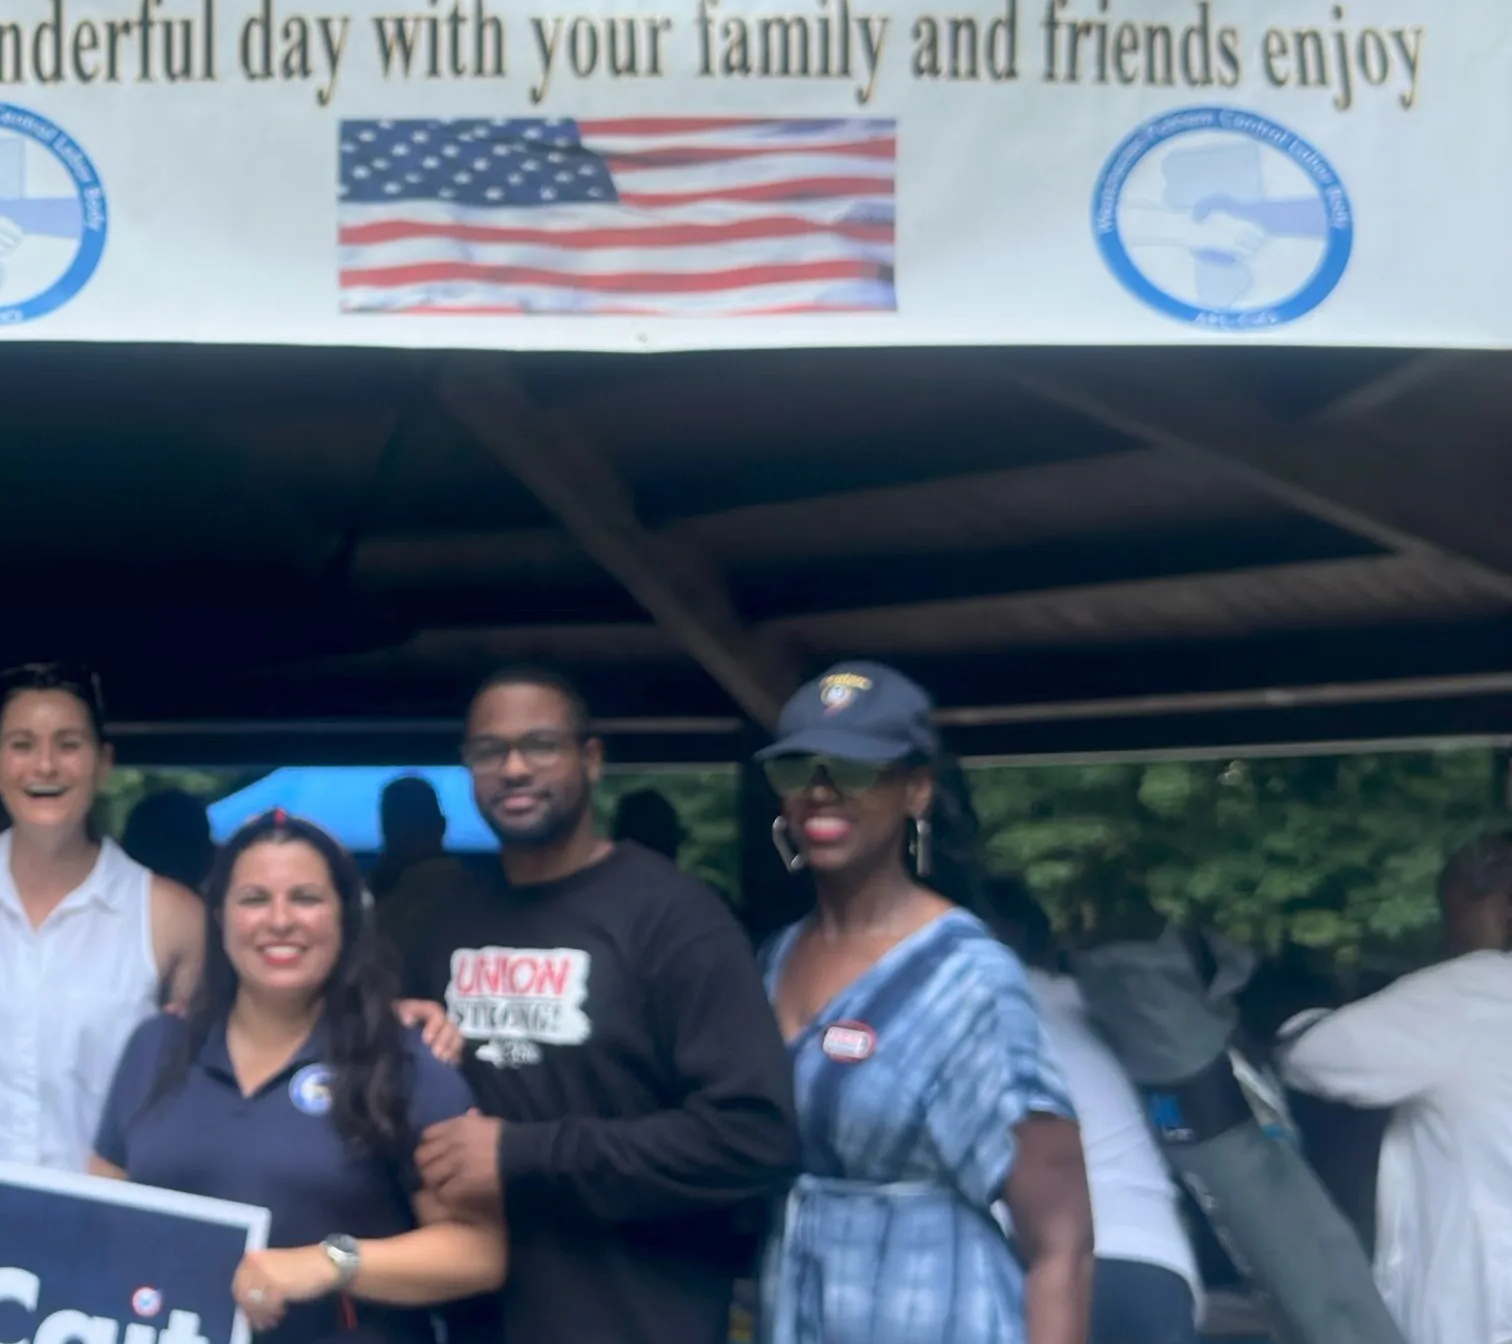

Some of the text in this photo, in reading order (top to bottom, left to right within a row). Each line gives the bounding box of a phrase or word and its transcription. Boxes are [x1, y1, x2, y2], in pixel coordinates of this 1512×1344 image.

[527, 14, 671, 104] your
[1261, 5, 1425, 112] enjoy
[456, 955, 570, 997] UNION
